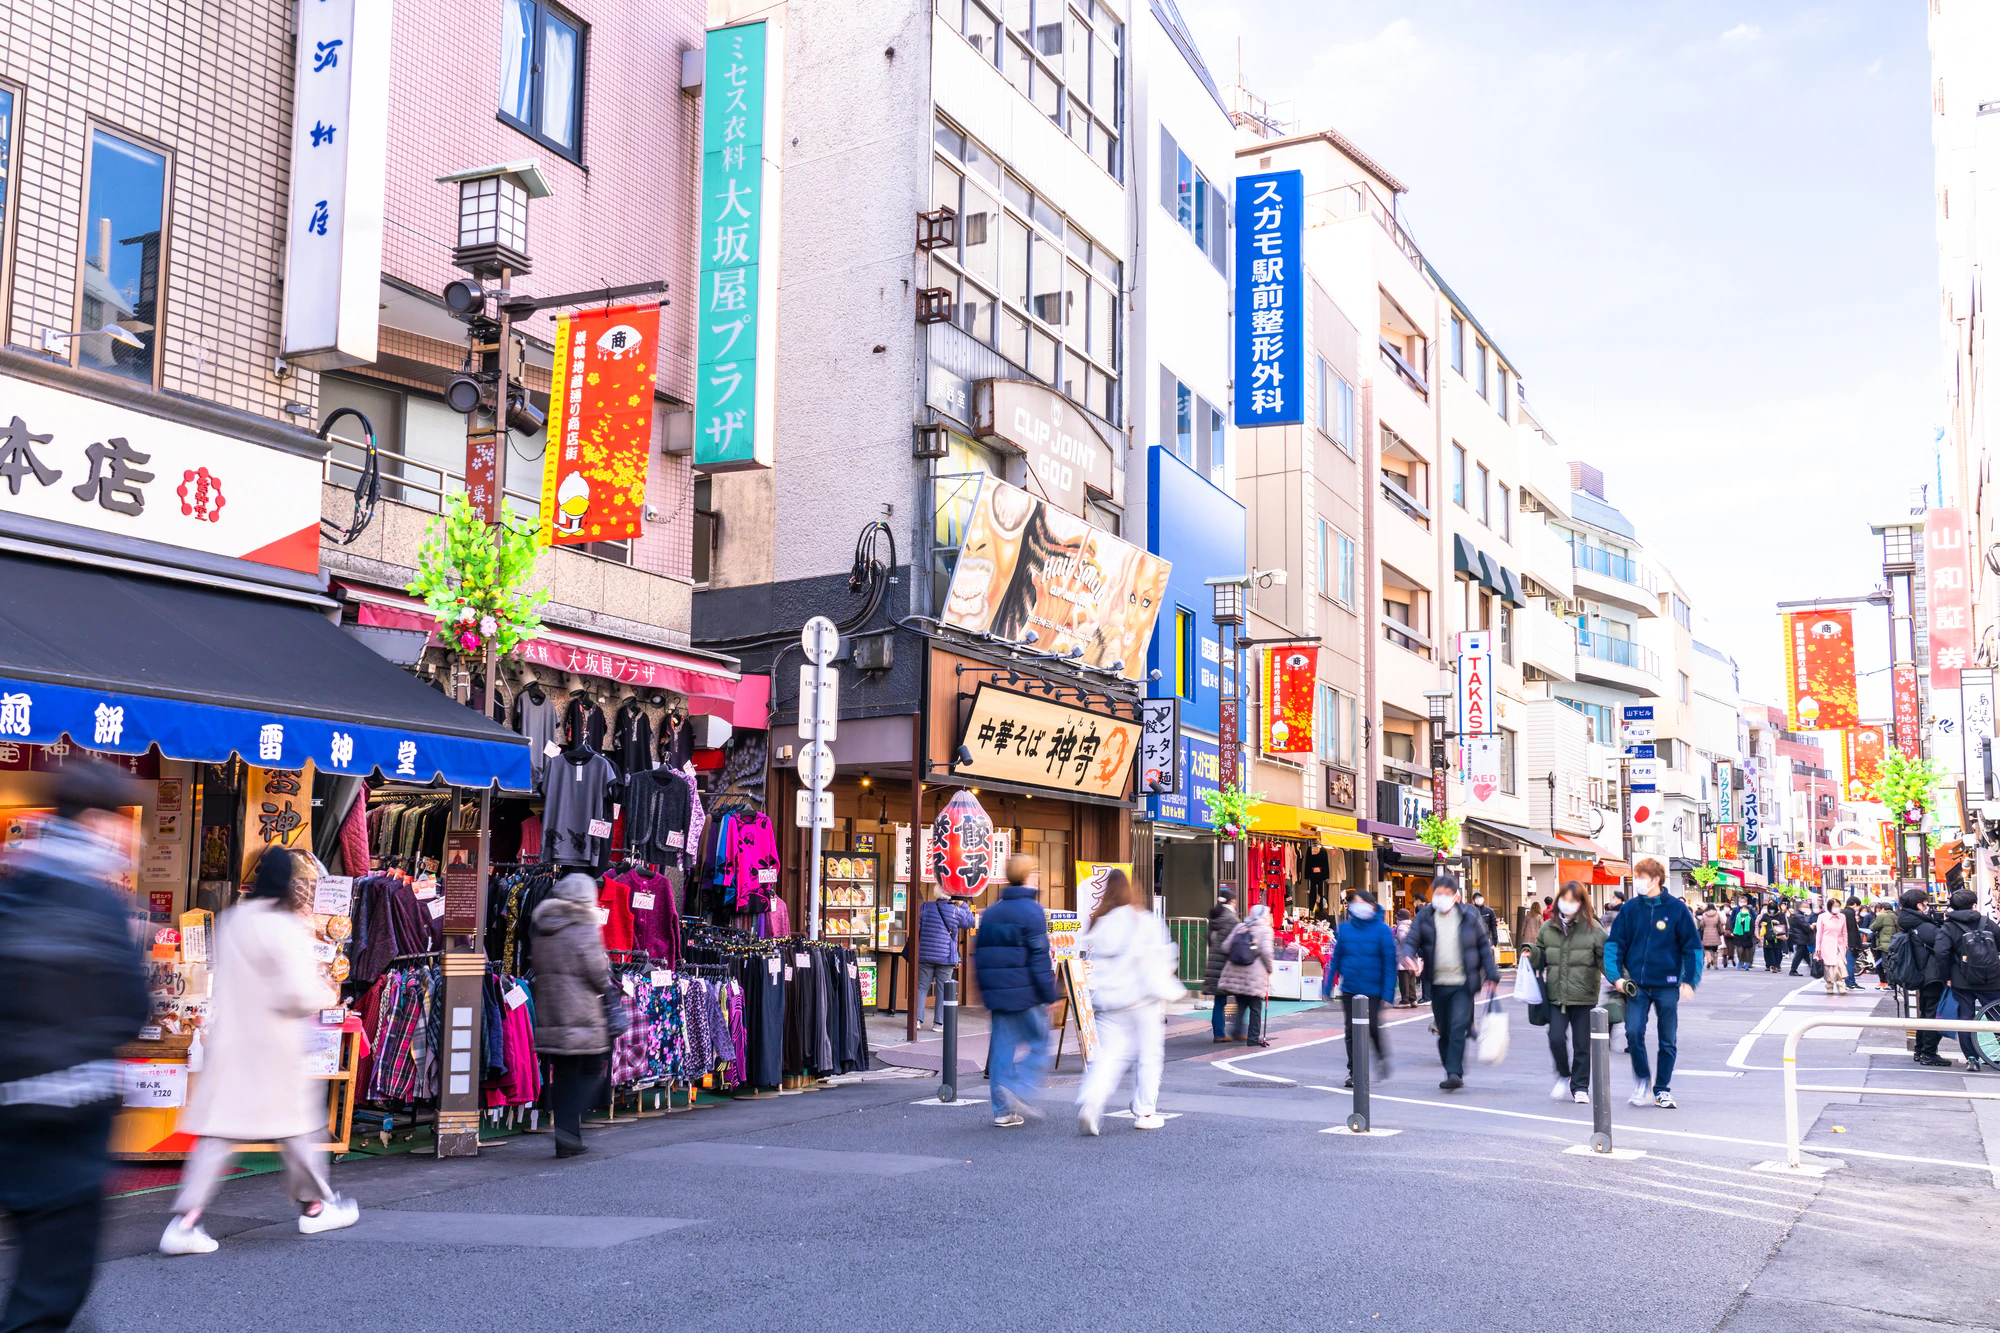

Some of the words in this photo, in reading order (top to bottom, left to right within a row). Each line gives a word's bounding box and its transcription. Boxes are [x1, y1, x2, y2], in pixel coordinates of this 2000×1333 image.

[721, 36, 749, 172] ミセス衣料
[704, 178, 752, 456] 大坂屋プラザ
[1251, 180, 1284, 415] スガモ駅前整形外科
[611, 331, 627, 349] 商
[565, 330, 588, 461] 巣鴨地蔵通り商店街
[0, 415, 156, 517] 本店
[1014, 406, 1050, 446] CLIP
[1051, 430, 1097, 473] JOINT
[1038, 453, 1073, 492] GOD
[1931, 526, 1967, 670] 山和証券
[566, 649, 656, 684] 大坂屋プラザ
[1293, 656, 1301, 665] 商
[1468, 657, 1483, 739] TAKASE
[0, 692, 124, 746] 煎餅
[258, 723, 417, 777] 雷神堂
[977, 717, 1047, 759] 中華そば
[1145, 719, 1158, 760] 餃子
[1158, 706, 1172, 786] ワンタン麺
[1472, 774, 1497, 783] AED
[1719, 767, 1730, 817] バッグハウス
[953, 814, 991, 888] 餃子
[1745, 793, 1758, 842] コバヤシ
[1053, 920, 1082, 932] 焼餃子
